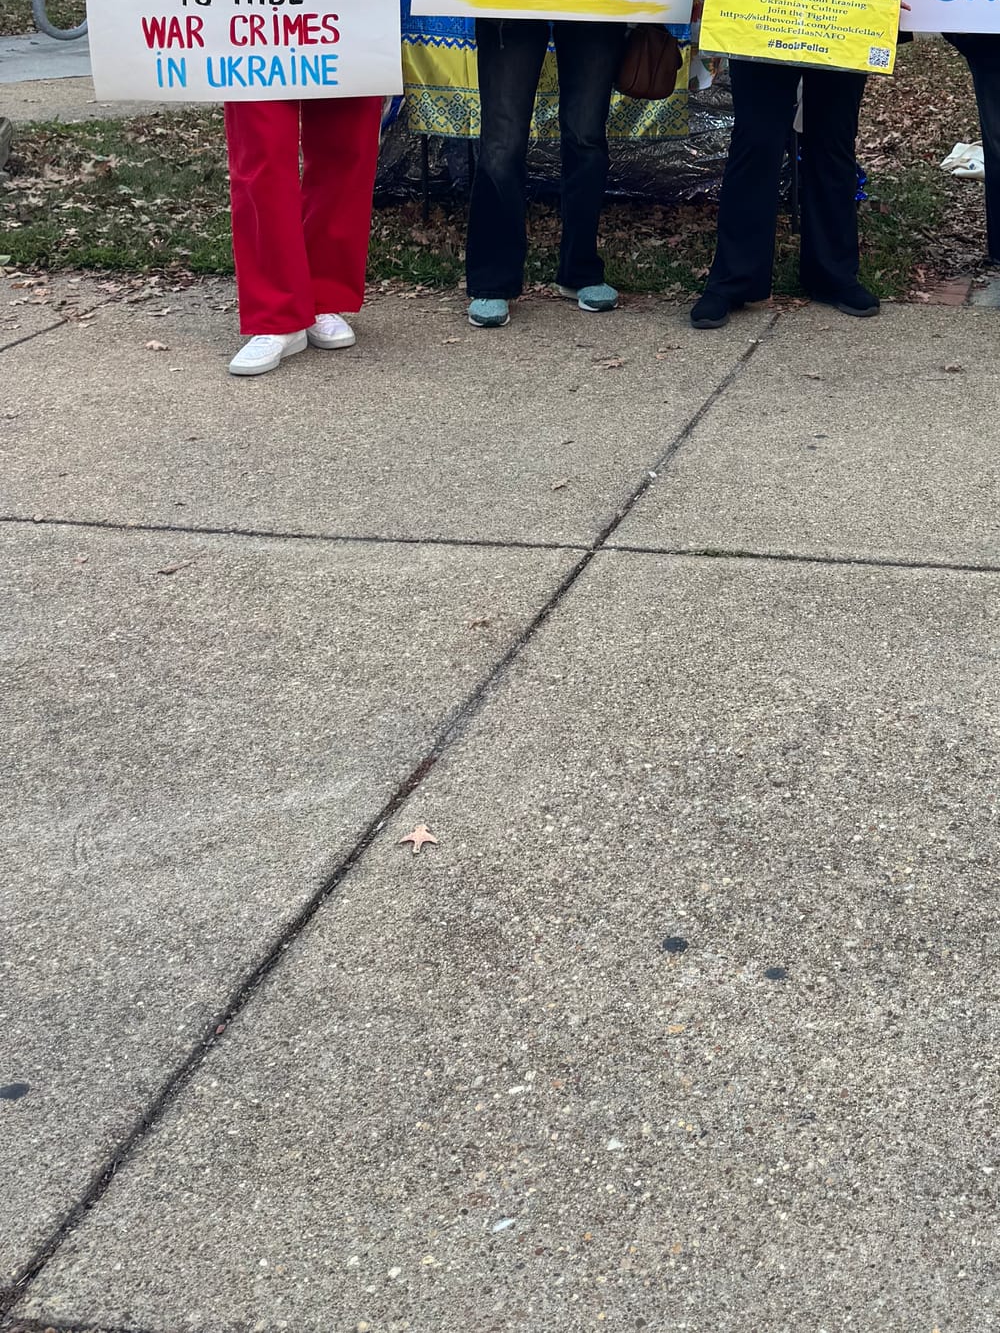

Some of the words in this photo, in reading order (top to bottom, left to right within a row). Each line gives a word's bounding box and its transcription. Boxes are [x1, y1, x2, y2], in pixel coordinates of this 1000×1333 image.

[767, 6, 787, 16] Join
[788, 8, 804, 17] the
[811, 3, 849, 15] Culture
[141, 15, 204, 48] WAR
[767, 39, 829, 54] #BookFellas
